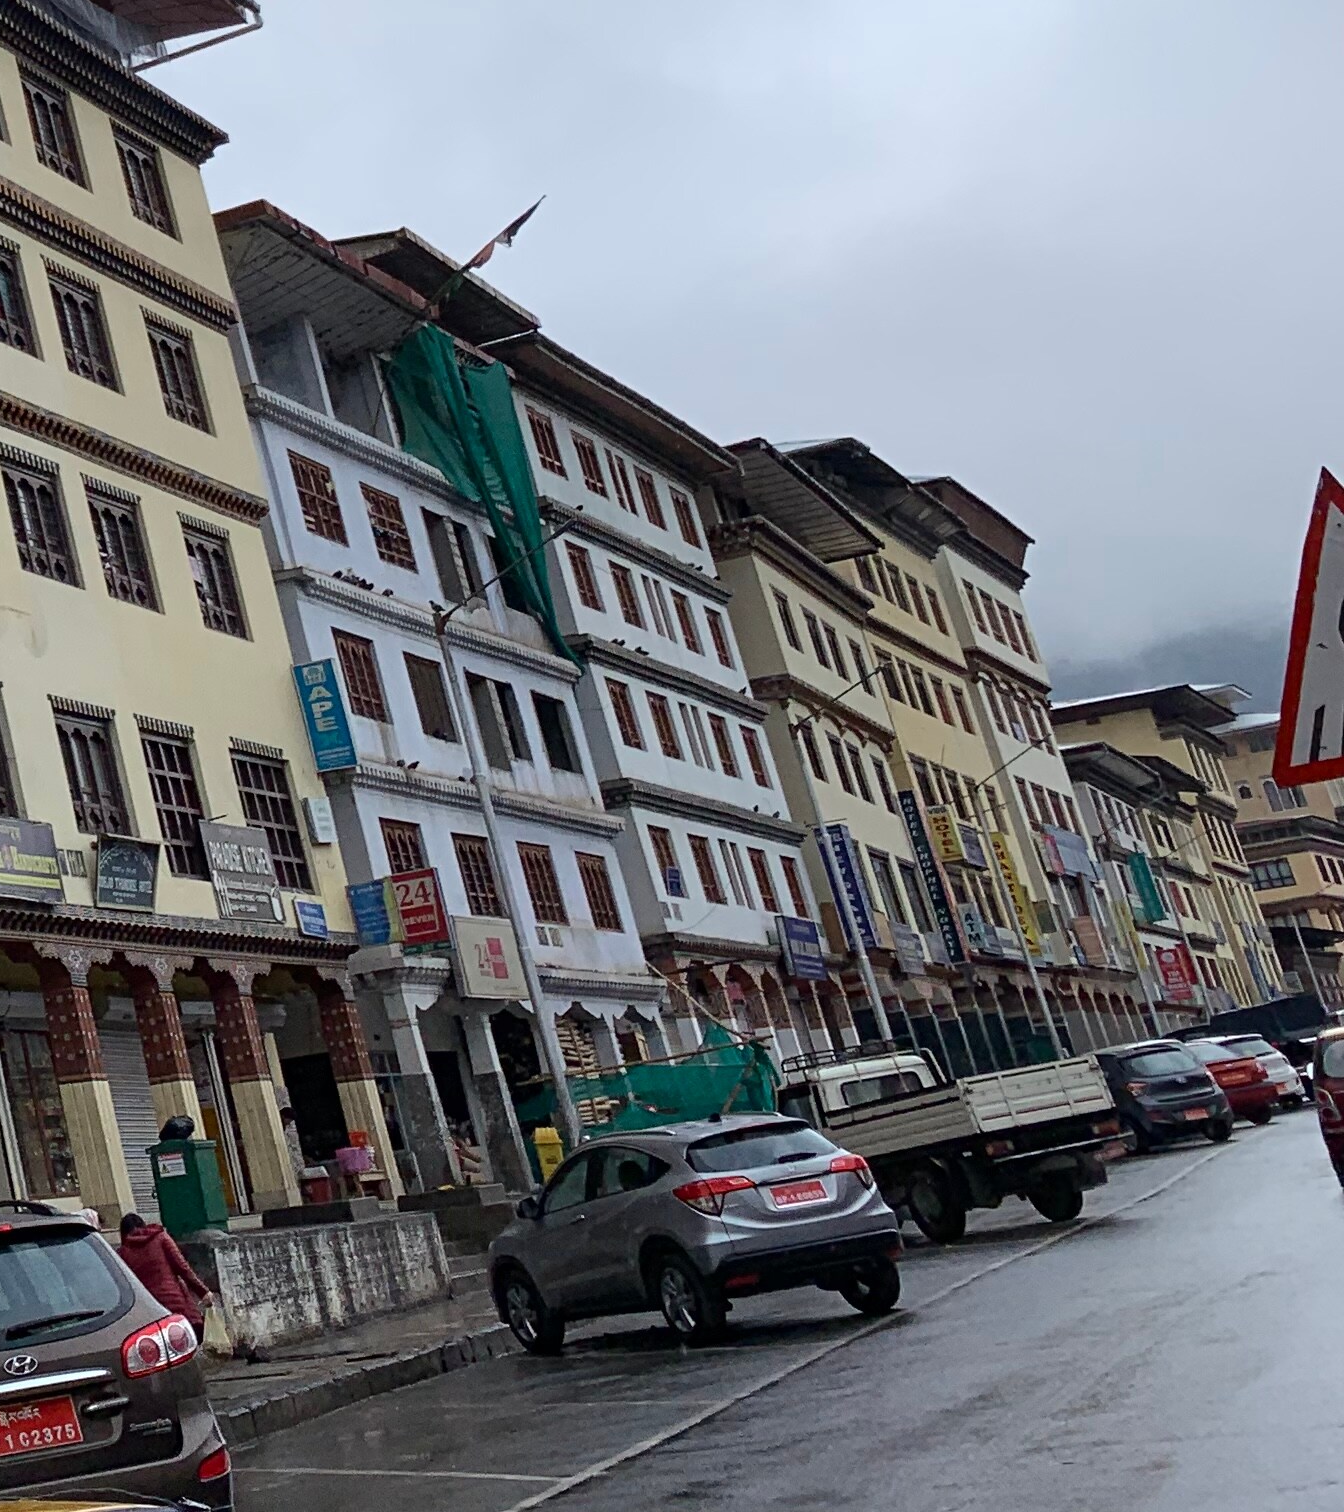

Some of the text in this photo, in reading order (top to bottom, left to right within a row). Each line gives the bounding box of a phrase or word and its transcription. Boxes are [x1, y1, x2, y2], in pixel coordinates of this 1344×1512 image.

[396, 880, 432, 908] 24
[403, 913, 436, 926] SEVEN
[964, 912, 982, 944] ATM
